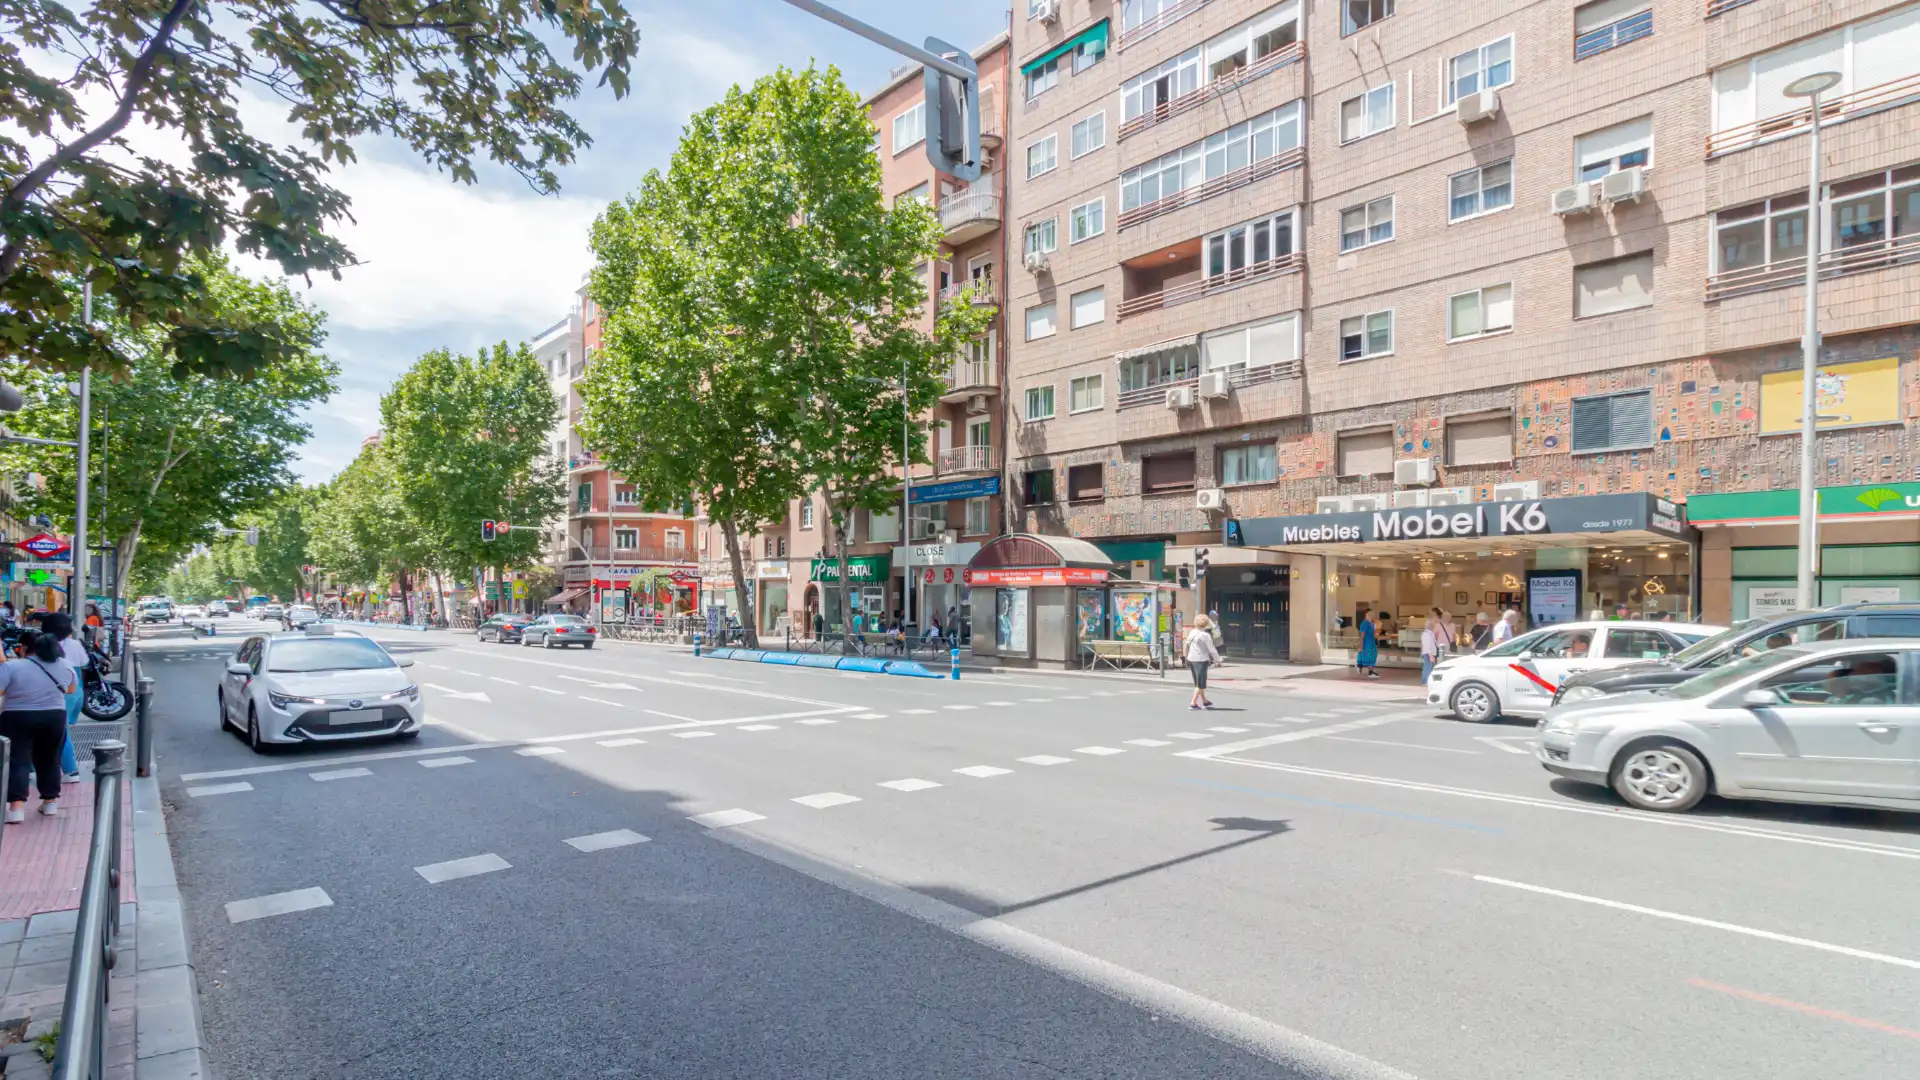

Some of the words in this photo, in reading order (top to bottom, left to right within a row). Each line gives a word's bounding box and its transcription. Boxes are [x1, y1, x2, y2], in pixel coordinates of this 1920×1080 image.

[1283, 524, 1360, 542] Muebles
[1373, 506, 1483, 538] Mobel
[1500, 502, 1546, 533] K6
[1582, 520, 1610, 528] desde
[916, 546, 944, 556] CLOSE
[1531, 579, 1560, 587] Mobel
[1563, 579, 1574, 587] K6
[1755, 598, 1779, 606] SOMOS
